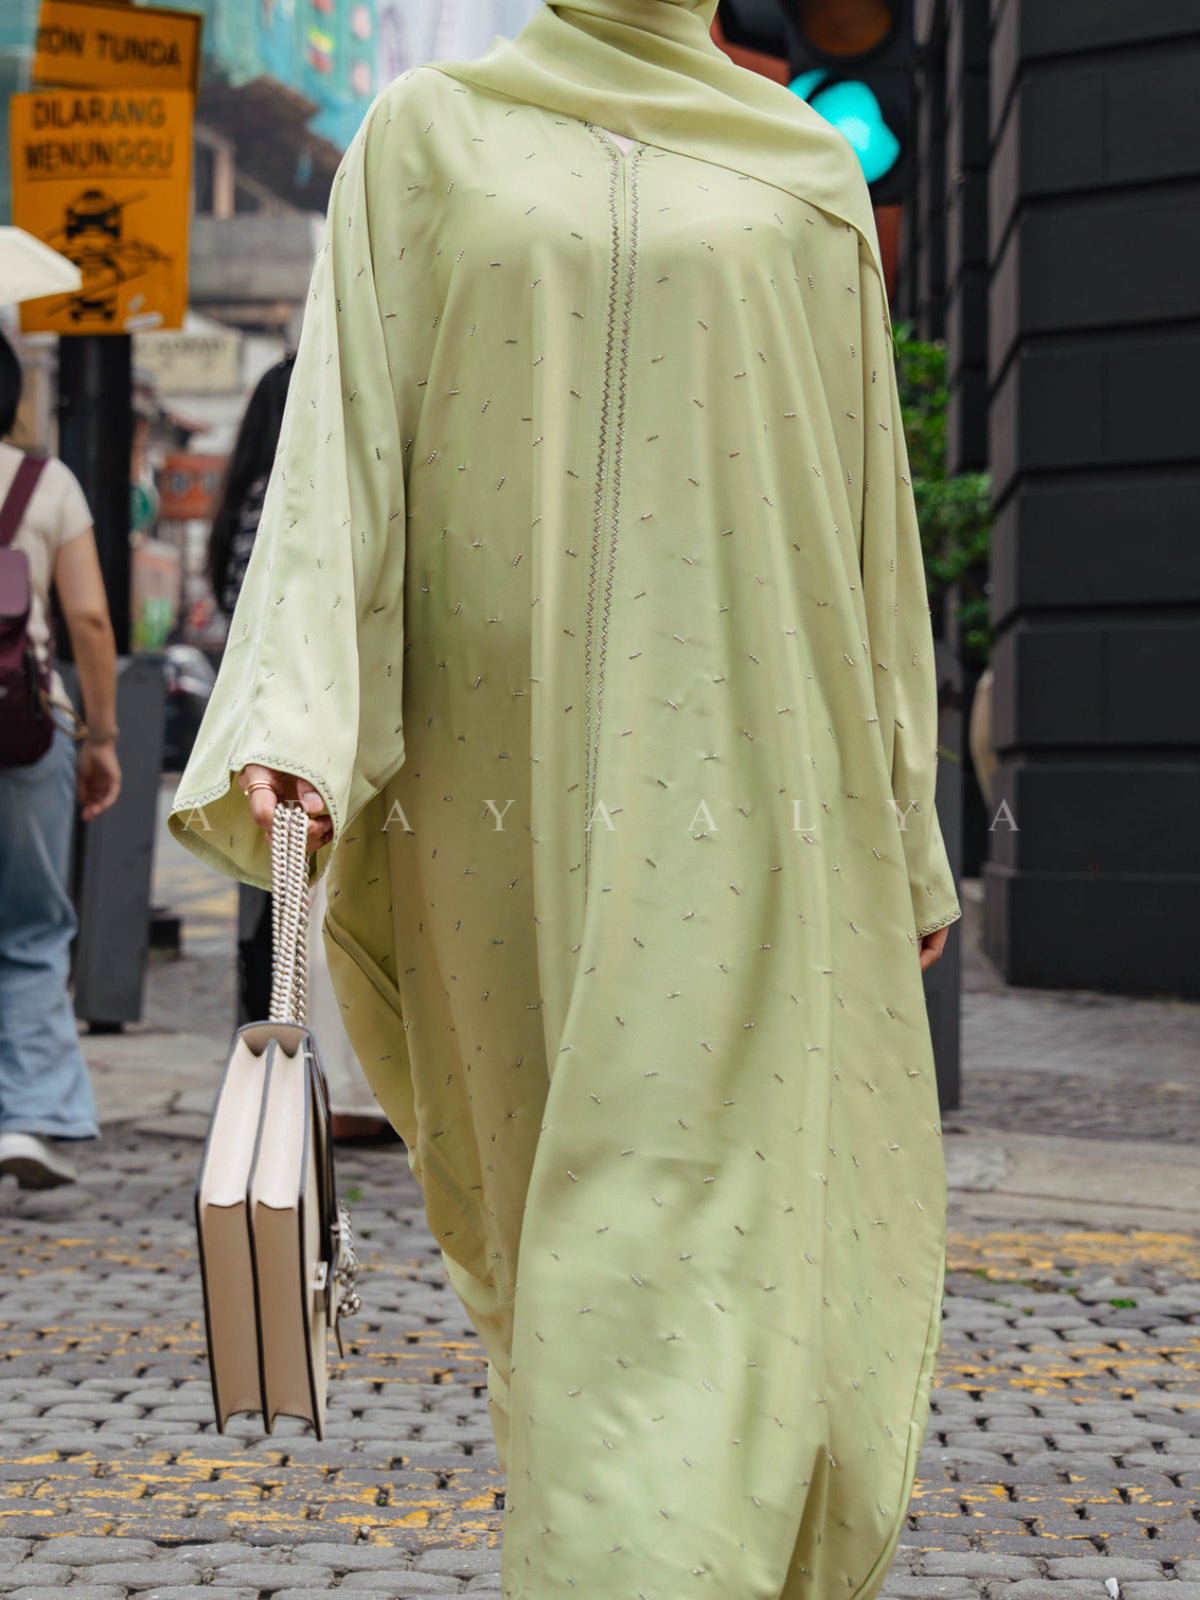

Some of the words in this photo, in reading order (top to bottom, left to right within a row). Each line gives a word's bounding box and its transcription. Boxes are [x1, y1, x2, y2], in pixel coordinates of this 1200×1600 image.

[96, 29, 181, 70] TUNDA
[33, 98, 166, 129] DILARANG
[25, 138, 173, 170] MENUNGGU
